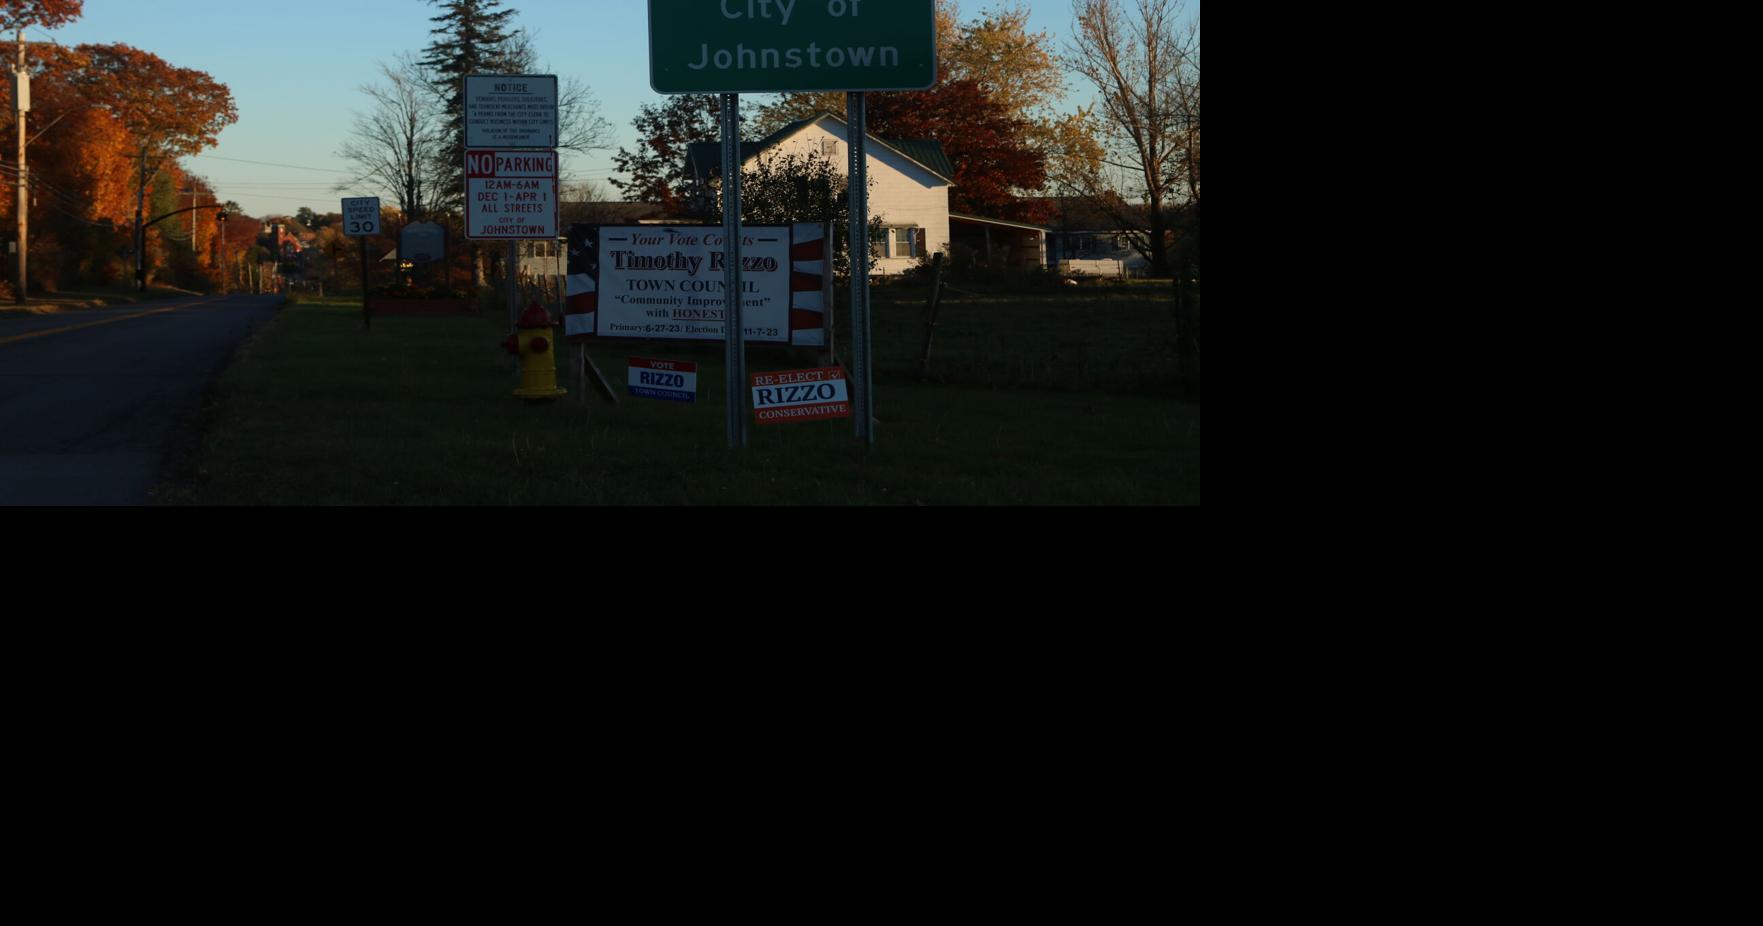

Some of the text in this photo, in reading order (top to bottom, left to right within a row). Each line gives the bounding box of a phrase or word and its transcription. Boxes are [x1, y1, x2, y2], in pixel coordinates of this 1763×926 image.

[720, 0, 864, 26] City of
[688, 41, 899, 70] Johnstown
[494, 83, 528, 92] NOTICE
[467, 153, 552, 175] NO PARKING
[485, 180, 539, 190] 12AM-6AM
[478, 192, 547, 202] DEC 1-APR 1
[481, 203, 543, 213] ALL STREETS
[350, 221, 374, 233] 30
[480, 225, 545, 234] JOHNSTOWN
[631, 233, 753, 246] Your Vote Cots
[610, 250, 778, 276] Timothy Rzzo
[626, 279, 760, 293] TOWN COUNIL
[646, 309, 726, 319] with HONEST
[685, 324, 719, 333] Election
[744, 328, 778, 337] 11-7-23
[649, 359, 674, 370] VOTE
[640, 371, 684, 388] RIZZO
[754, 371, 824, 386] RE-ELECT
[756, 383, 836, 405] RIZZO
[758, 404, 847, 419] CONSERVATIVE
